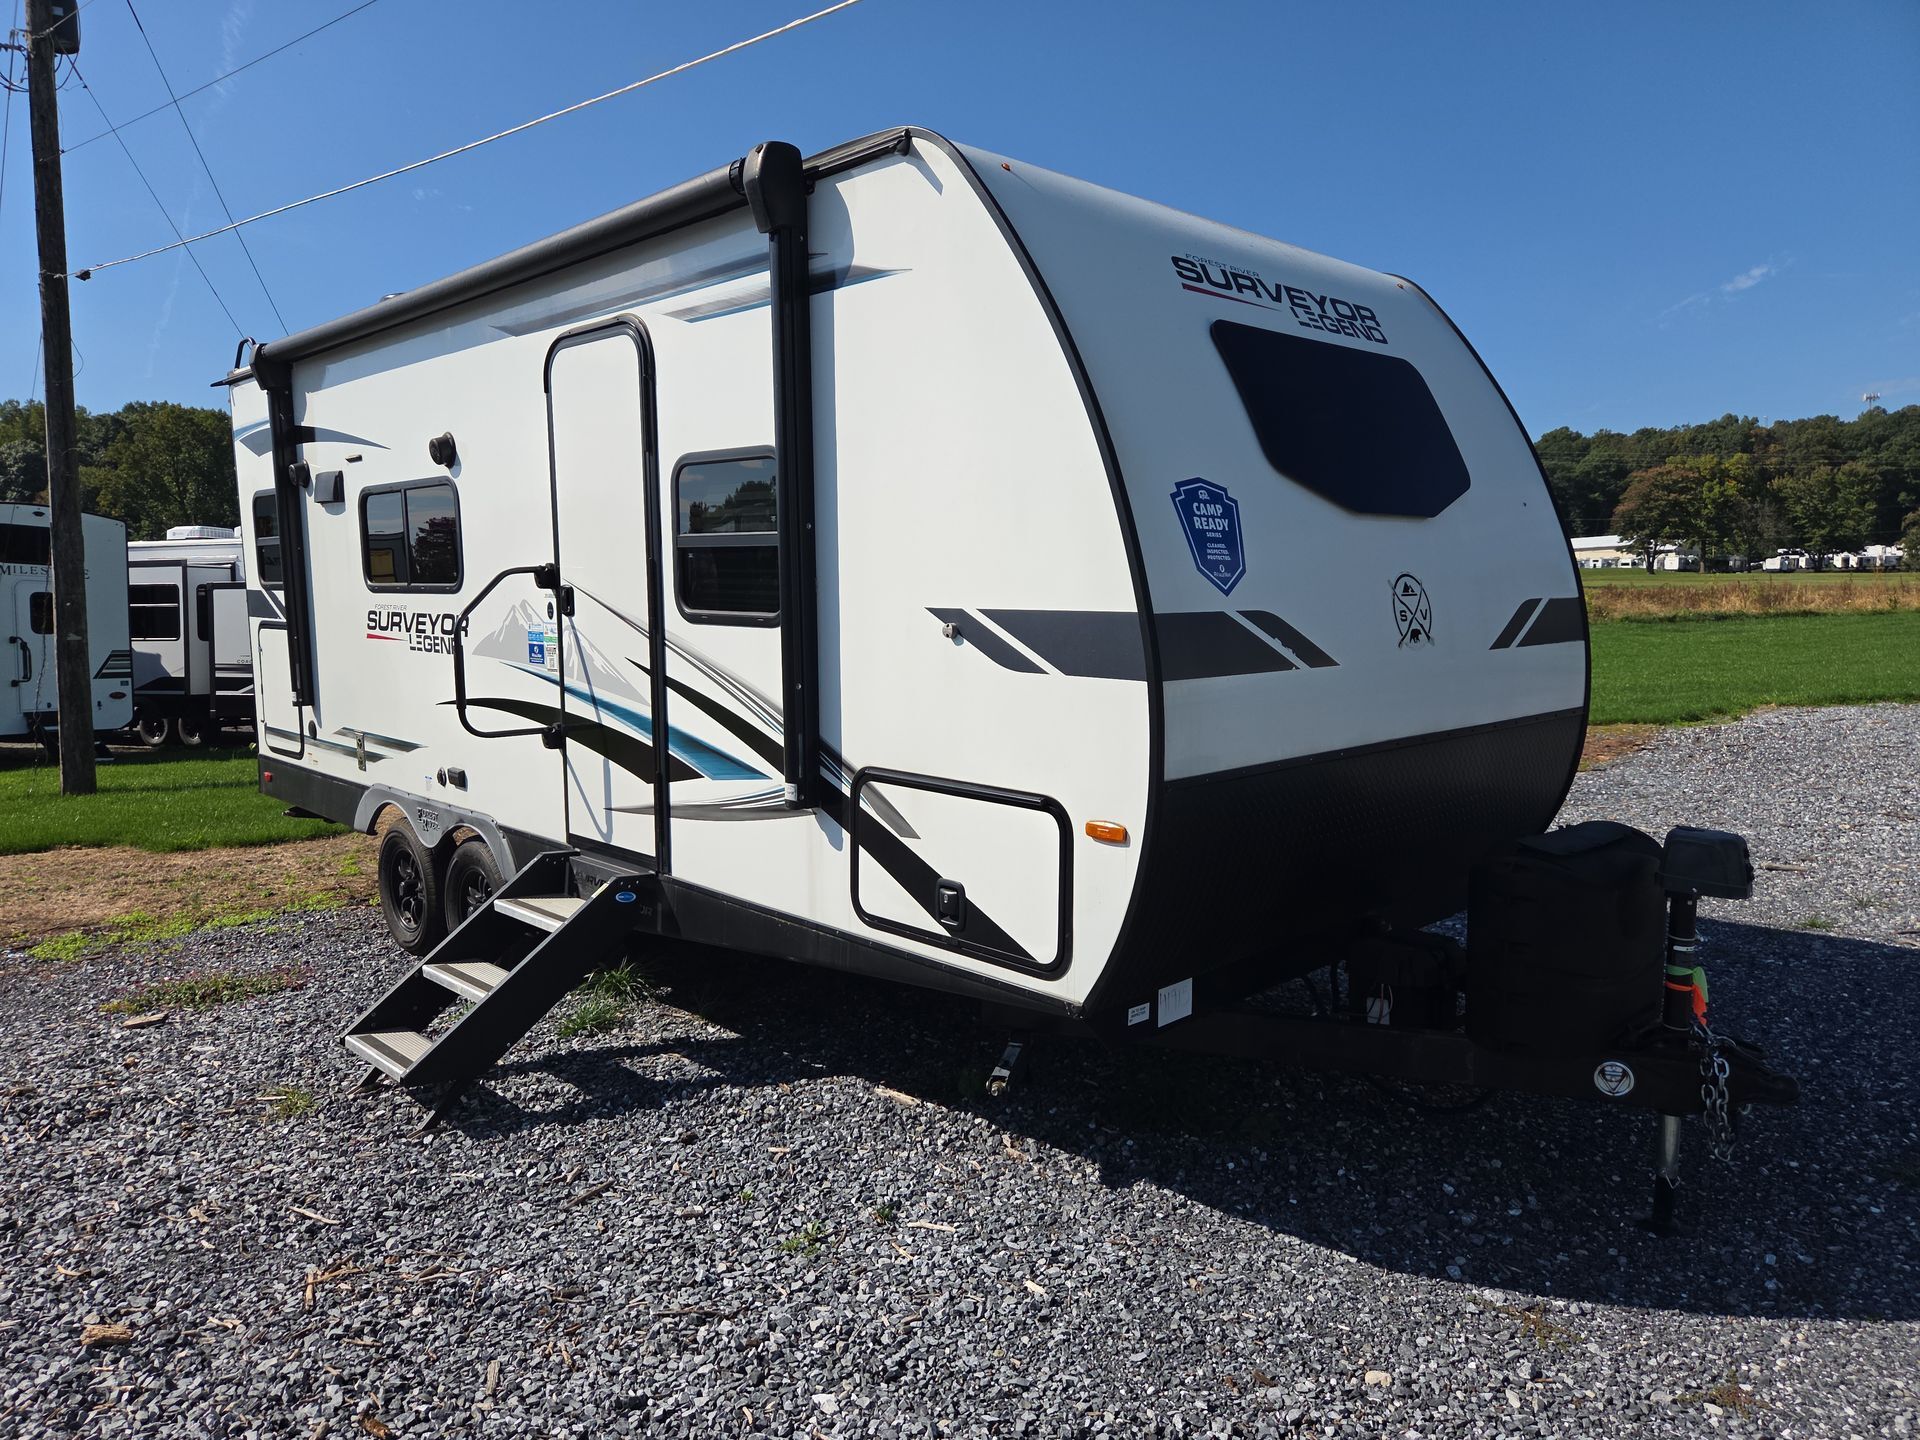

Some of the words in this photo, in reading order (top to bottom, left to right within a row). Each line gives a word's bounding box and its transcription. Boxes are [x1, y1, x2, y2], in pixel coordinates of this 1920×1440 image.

[1185, 253, 1227, 269] FOREST
[1229, 265, 1260, 277] RIVER
[1171, 255, 1382, 328] SURVEYOR
[1289, 306, 1389, 345] LEGEND
[1193, 502, 1223, 516] CAMP
[1193, 517, 1229, 531] READY
[0, 564, 90, 580] MILESE
[374, 603, 392, 611] FOREST
[408, 633, 456, 655] LEGEN
